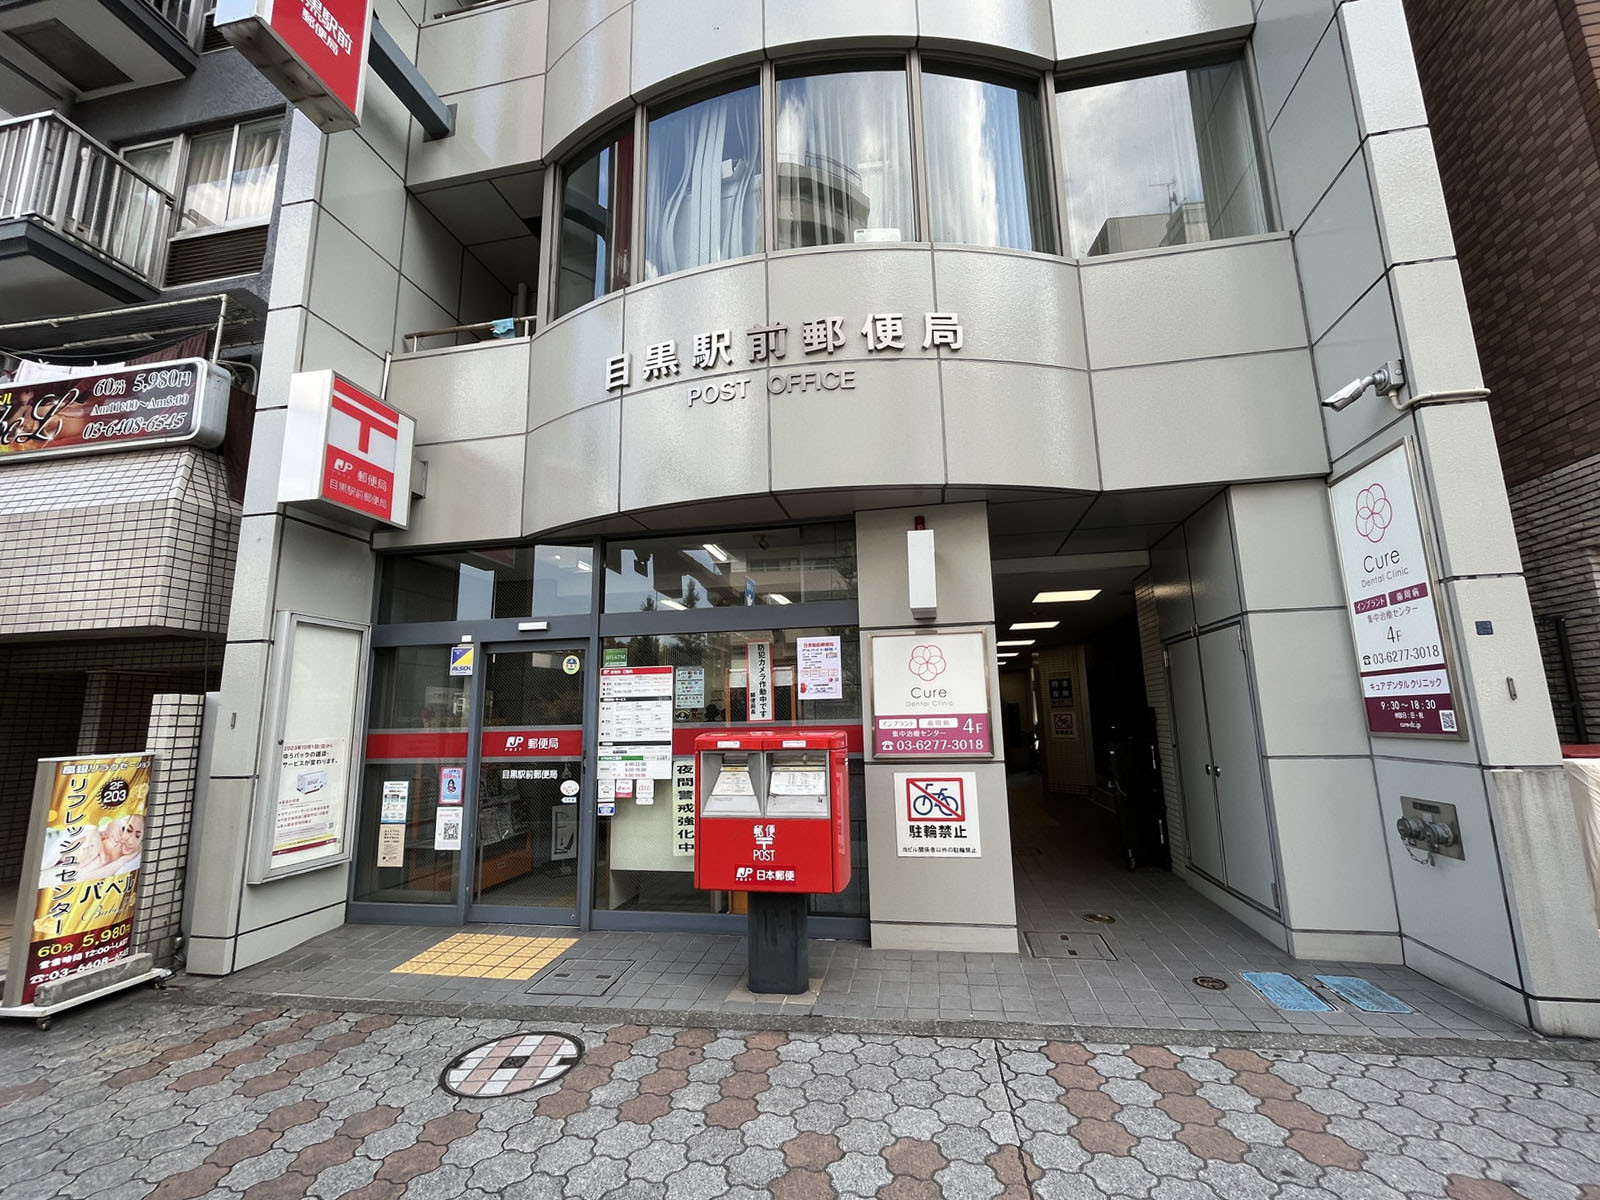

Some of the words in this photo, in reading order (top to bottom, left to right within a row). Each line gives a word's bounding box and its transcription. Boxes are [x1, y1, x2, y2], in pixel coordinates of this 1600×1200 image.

[301, 0, 353, 55] 黒駅前
[301, 7, 339, 56] 郵便局
[605, 313, 964, 392] 目黒駅前郵便局
[688, 378, 751, 407] POST
[767, 369, 857, 395] OFFICE
[357, 469, 387, 492] 郵便局
[1363, 549, 1400, 573] Cure
[1361, 577, 1384, 588] Dental
[1386, 567, 1409, 580] Clinic
[1356, 597, 1385, 611] インプラント
[1387, 625, 1402, 643] 4F
[1373, 644, 1440, 665] 03-6277-3018
[757, 643, 768, 718] 防犯カメラ作動中です
[1370, 678, 1442, 691] キュアデンタルクリニック
[910, 687, 947, 699] Cure
[891, 730, 947, 738] 集中治療センター
[962, 718, 983, 734] 4F
[527, 737, 559, 749] 郵便局
[896, 739, 984, 751] 03-6277-3018
[502, 769, 558, 780] 目黒駅前郵便局
[109, 781, 124, 790] 2F
[103, 790, 127, 803] 203
[677, 764, 695, 853] 夜間警戒強化中
[753, 824, 776, 838] 郵便
[909, 824, 968, 839] 駐輪禁止
[50, 777, 88, 935] リフレッシュセンター
[753, 849, 776, 862] POST
[756, 869, 795, 881] 日本郵便
[80, 876, 135, 904] バベル
[37, 942, 73, 958] 60分
